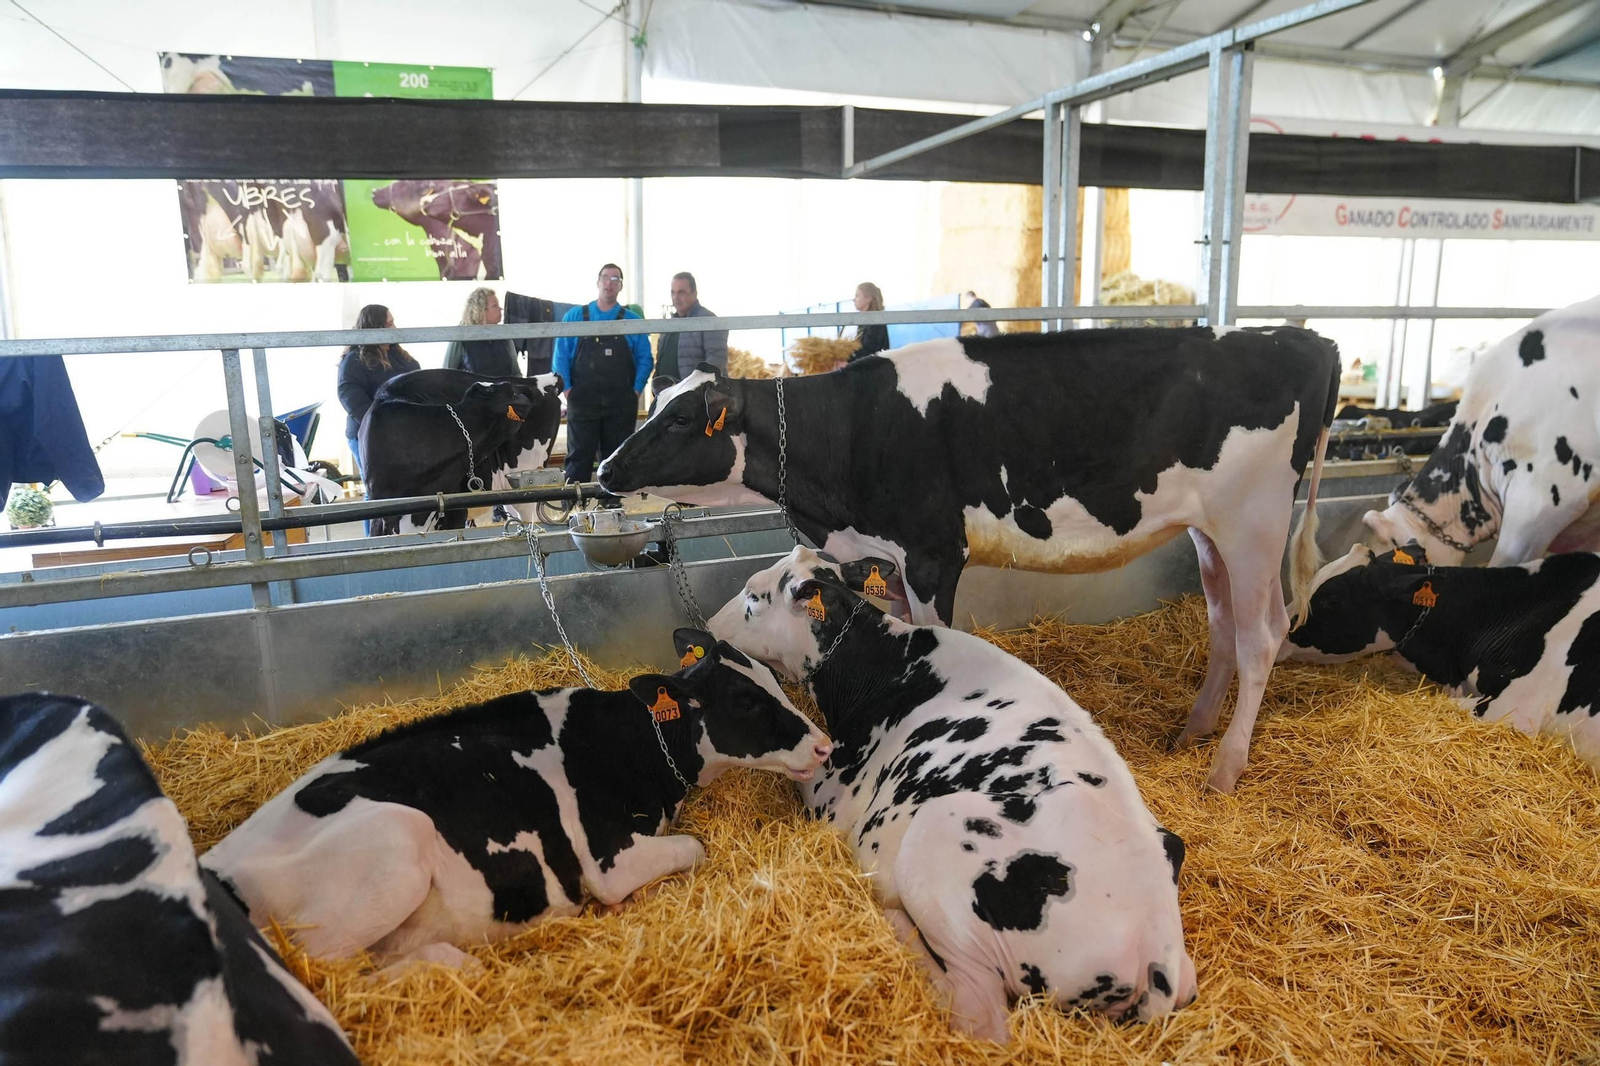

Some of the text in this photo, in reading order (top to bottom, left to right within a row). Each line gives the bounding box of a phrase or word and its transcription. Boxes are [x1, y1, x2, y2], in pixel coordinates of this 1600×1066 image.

[399, 72, 430, 89] 200
[221, 185, 316, 209] UBRES
[1335, 205, 1596, 233] GANADO CONTROLADO SANITARIAMENTE
[405, 231, 415, 246] la
[449, 242, 468, 259] alta
[865, 585, 885, 596] 0536
[655, 707, 678, 722] 0073
